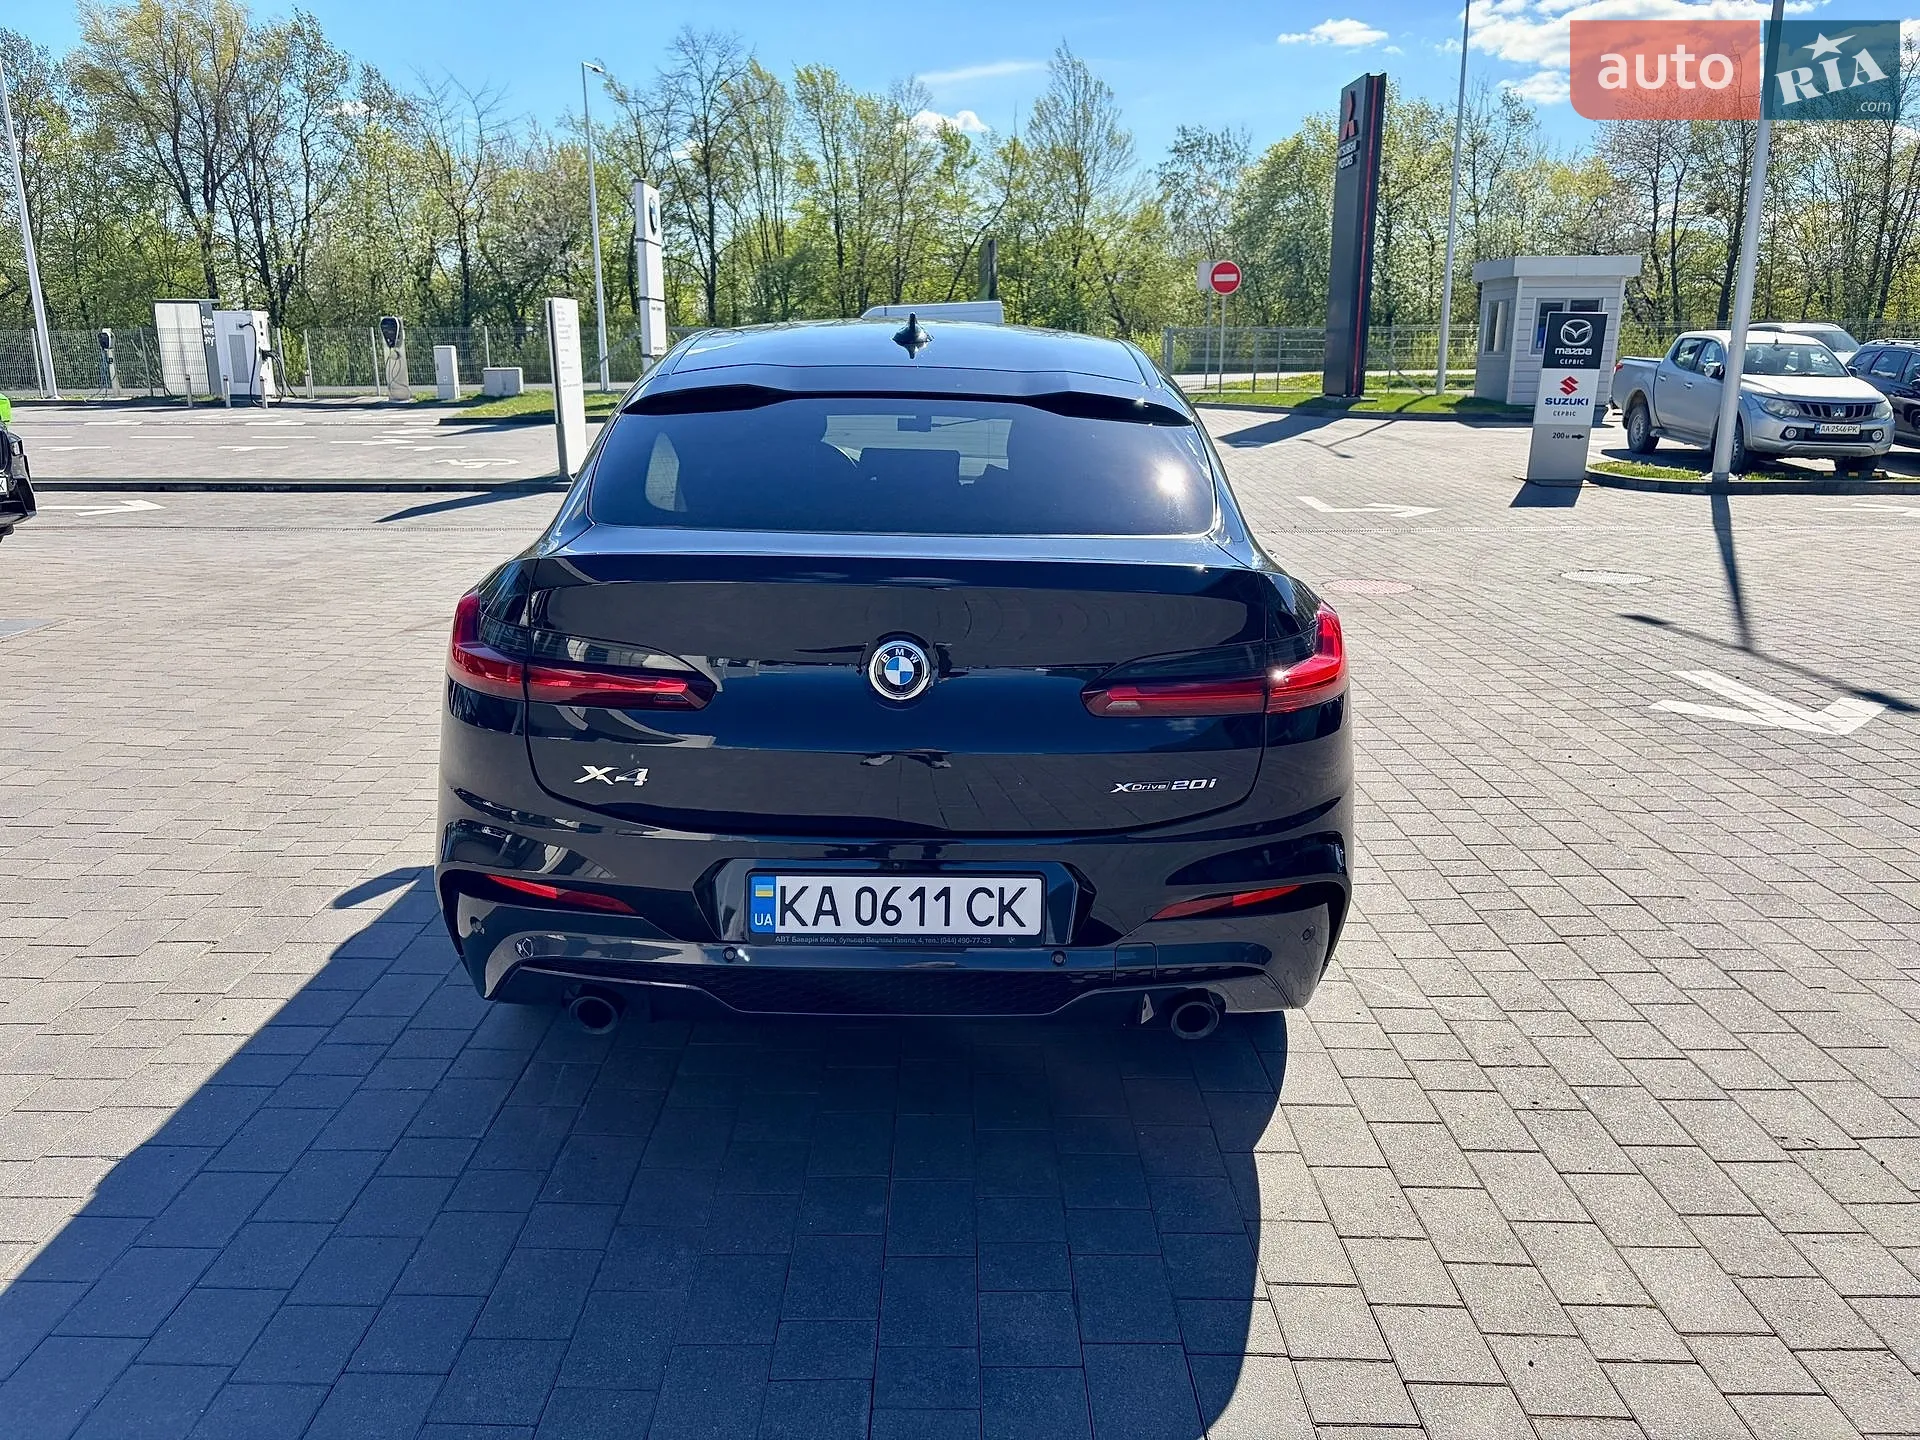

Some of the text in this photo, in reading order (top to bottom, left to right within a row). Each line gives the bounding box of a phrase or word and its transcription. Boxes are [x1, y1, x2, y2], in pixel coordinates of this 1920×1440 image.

[1545, 397, 1589, 406] SUZUKI
[1552, 432, 1565, 440] 200
[881, 648, 920, 664] BMW
[573, 765, 649, 786] X4
[1171, 778, 1217, 791] 20i
[779, 885, 1028, 928] KA 0611 CK
[754, 913, 773, 926] UA
